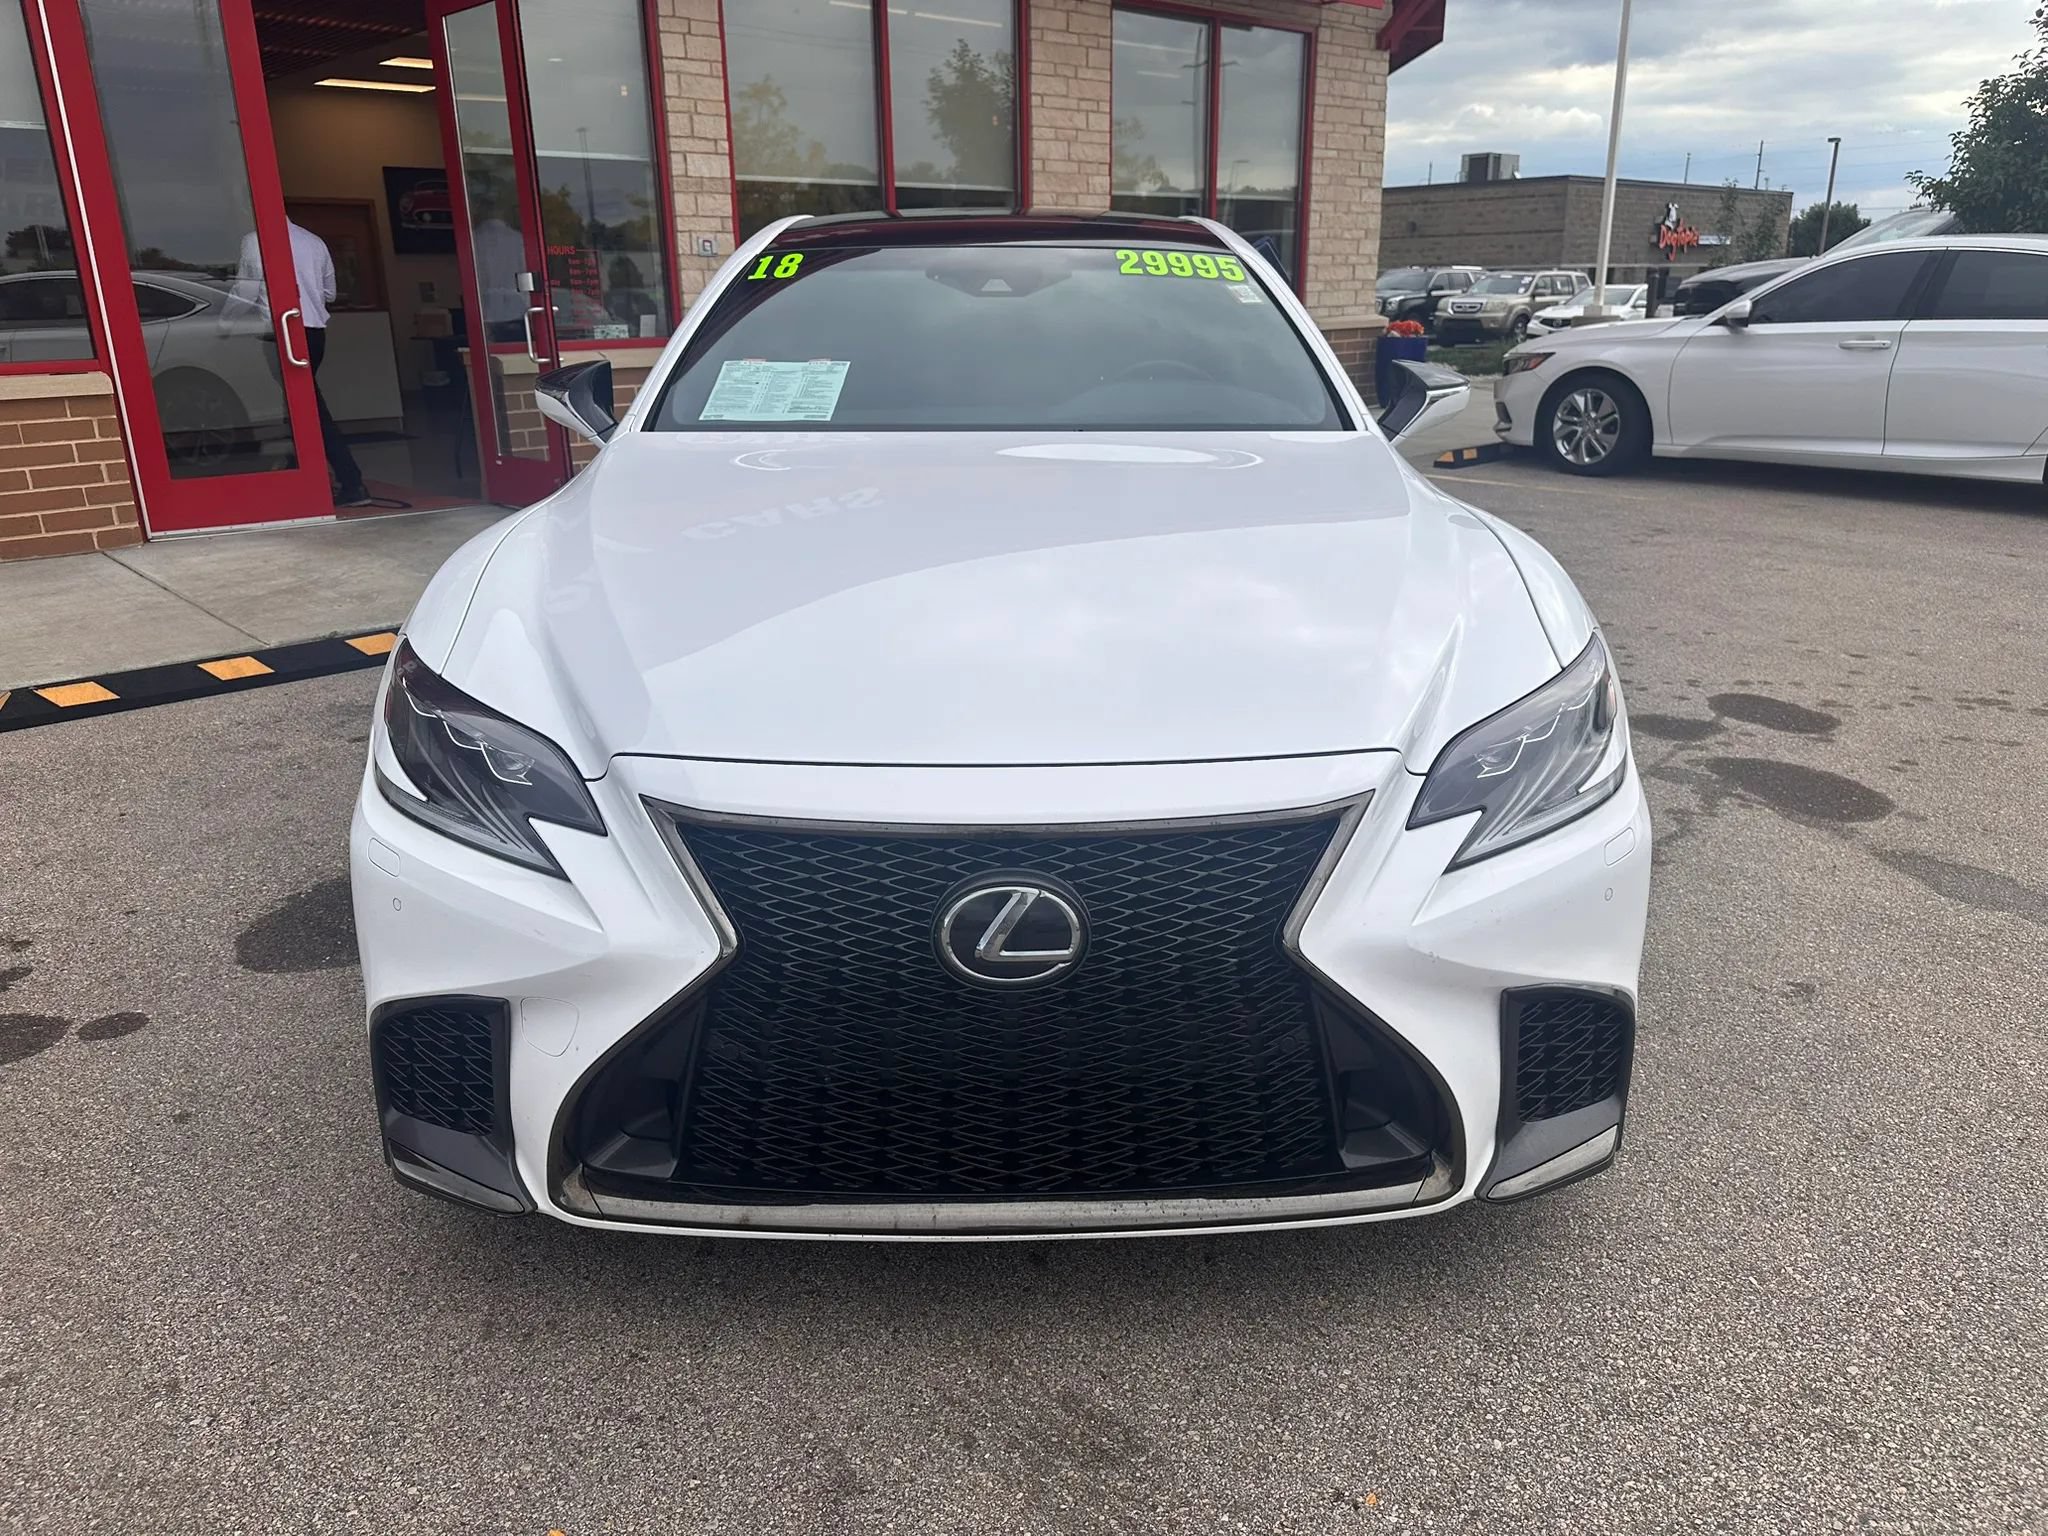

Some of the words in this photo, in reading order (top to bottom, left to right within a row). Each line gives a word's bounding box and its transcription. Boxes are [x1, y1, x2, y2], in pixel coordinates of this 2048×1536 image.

[547, 245, 576, 256] HOURS
[747, 253, 805, 280] 18
[1115, 249, 1246, 282] 29995
